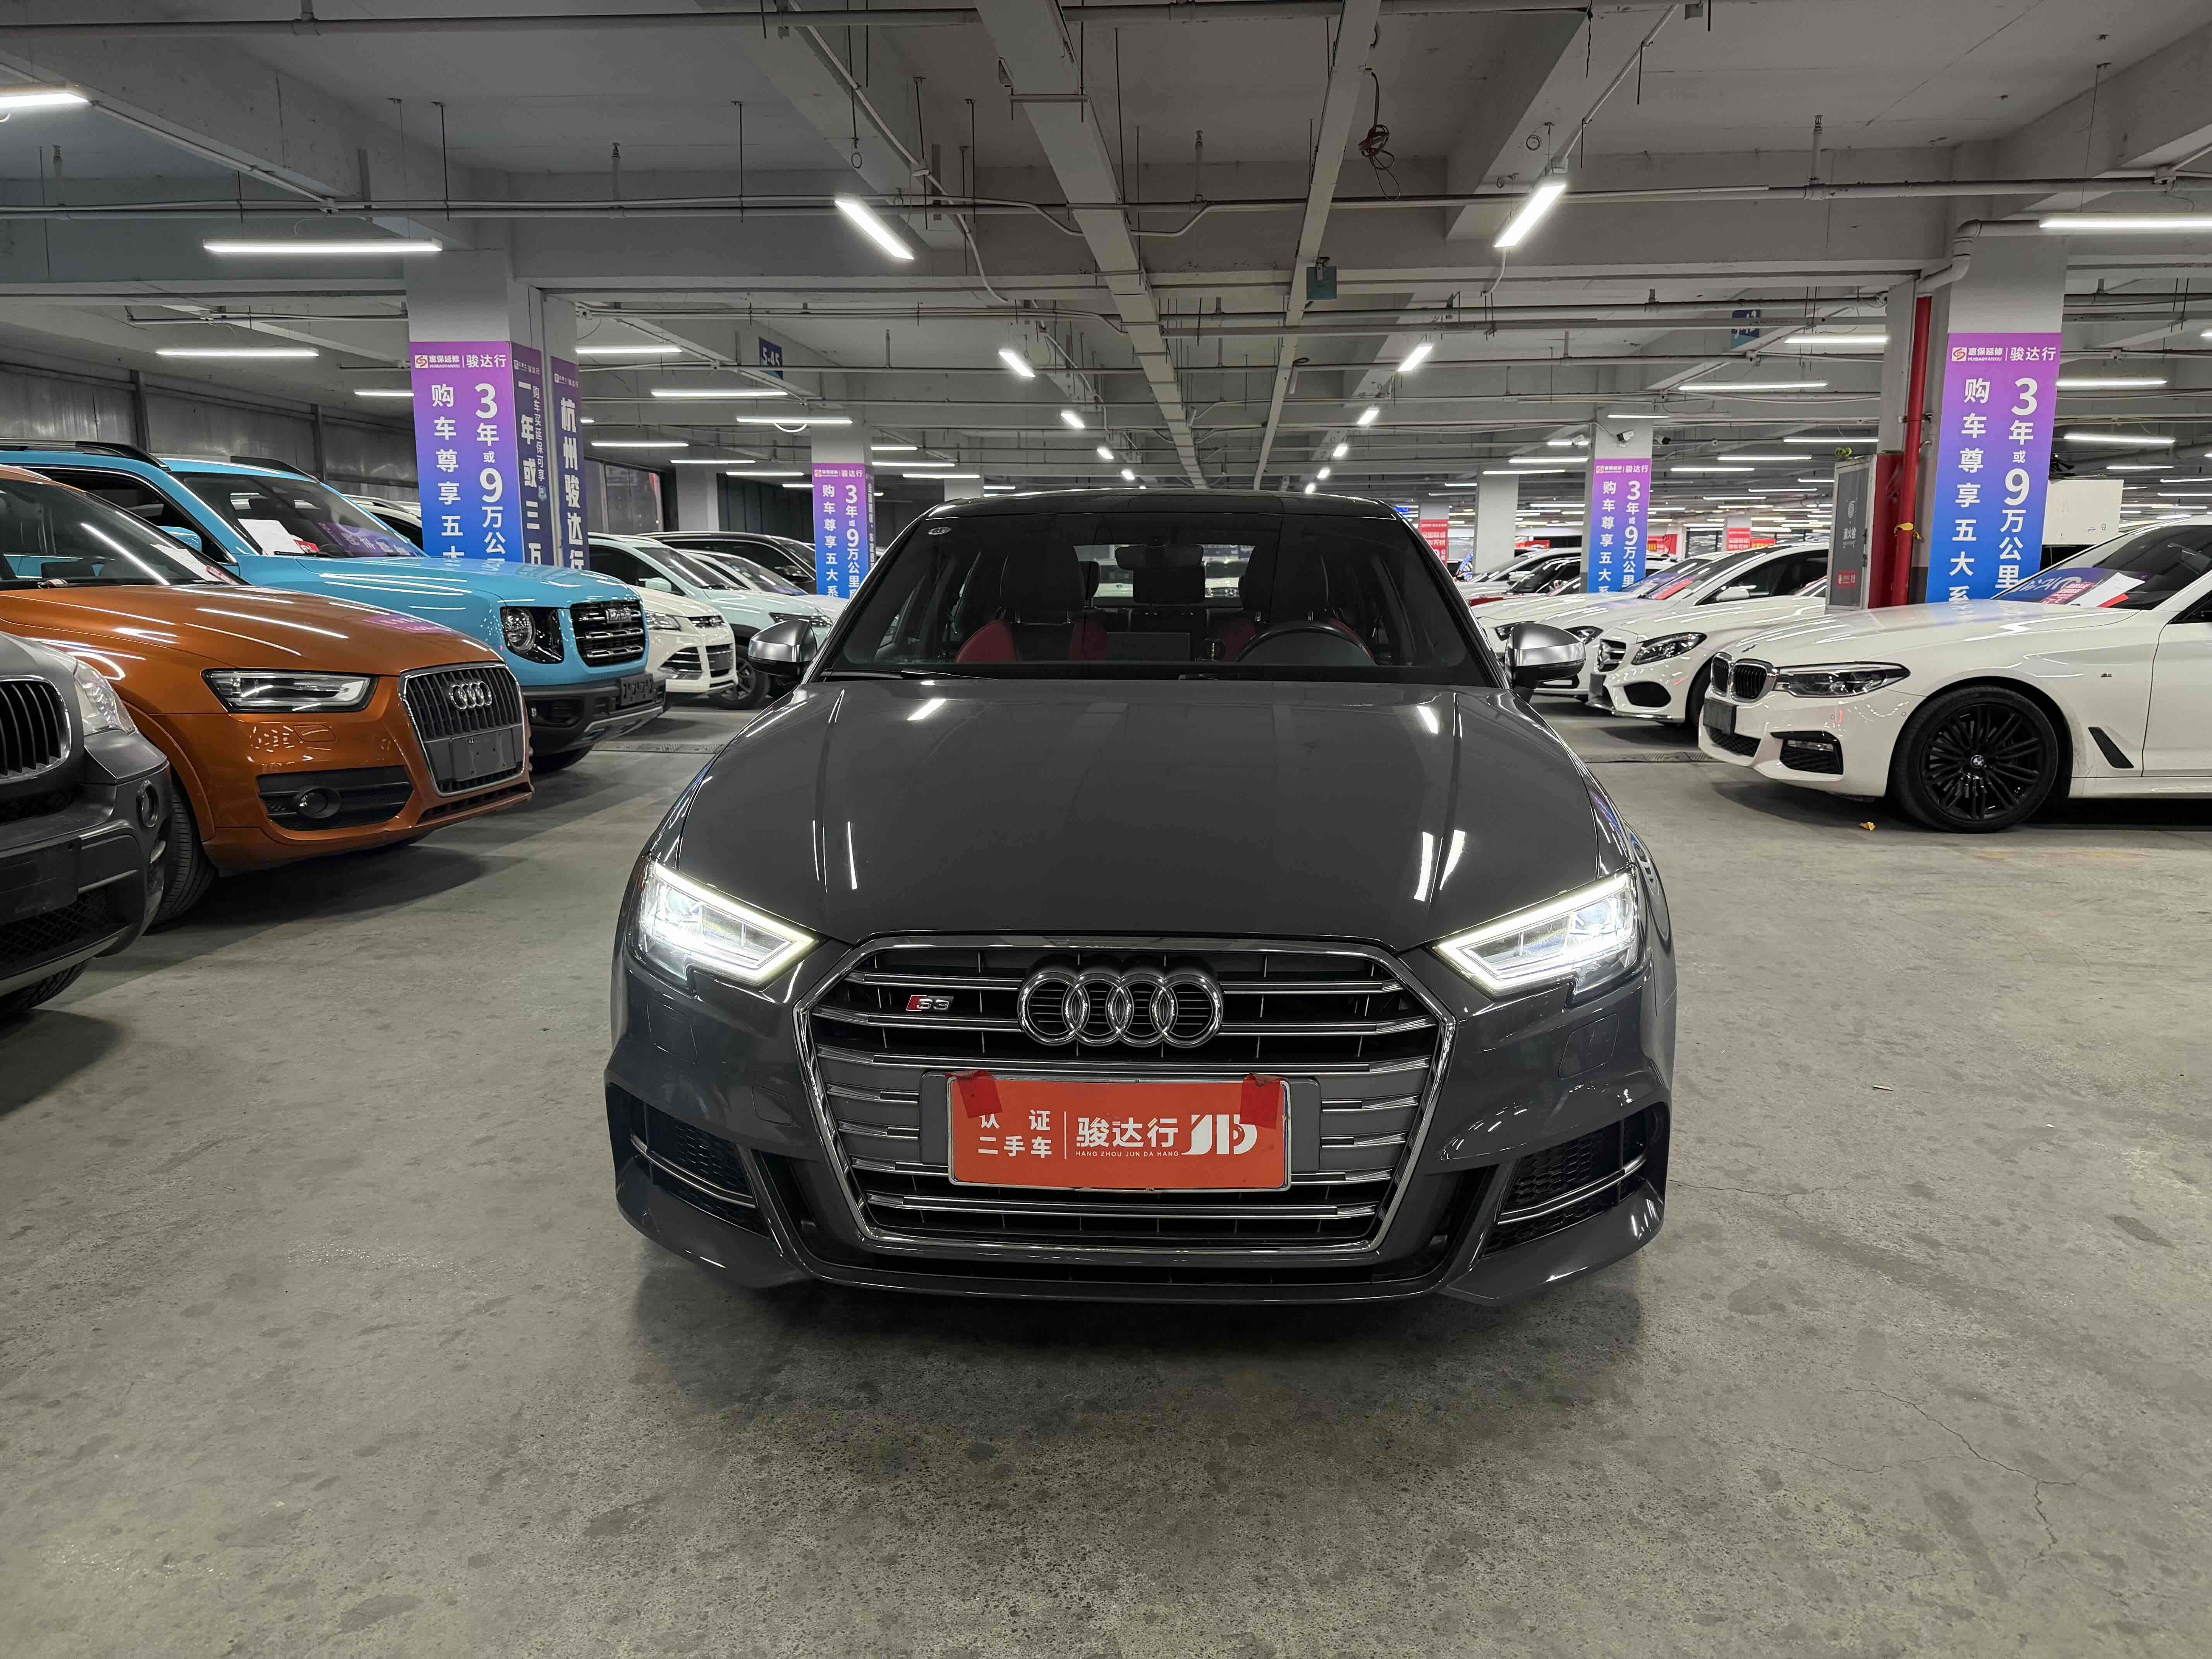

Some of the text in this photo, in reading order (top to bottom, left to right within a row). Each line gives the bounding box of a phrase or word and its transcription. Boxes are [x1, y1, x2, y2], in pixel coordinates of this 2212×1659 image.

[466, 354, 507, 368] 骏达行
[1968, 347, 2056, 361] 惠保延修 骏达行
[474, 383, 506, 562] 3年或9万公
[560, 397, 584, 570] 杭州骏达行
[1995, 377, 2038, 589] 3年或9万公里
[916, 998, 950, 1010] S3
[1076, 1117, 1178, 1147] 骏达行
[978, 1135, 1052, 1158] 二手车
